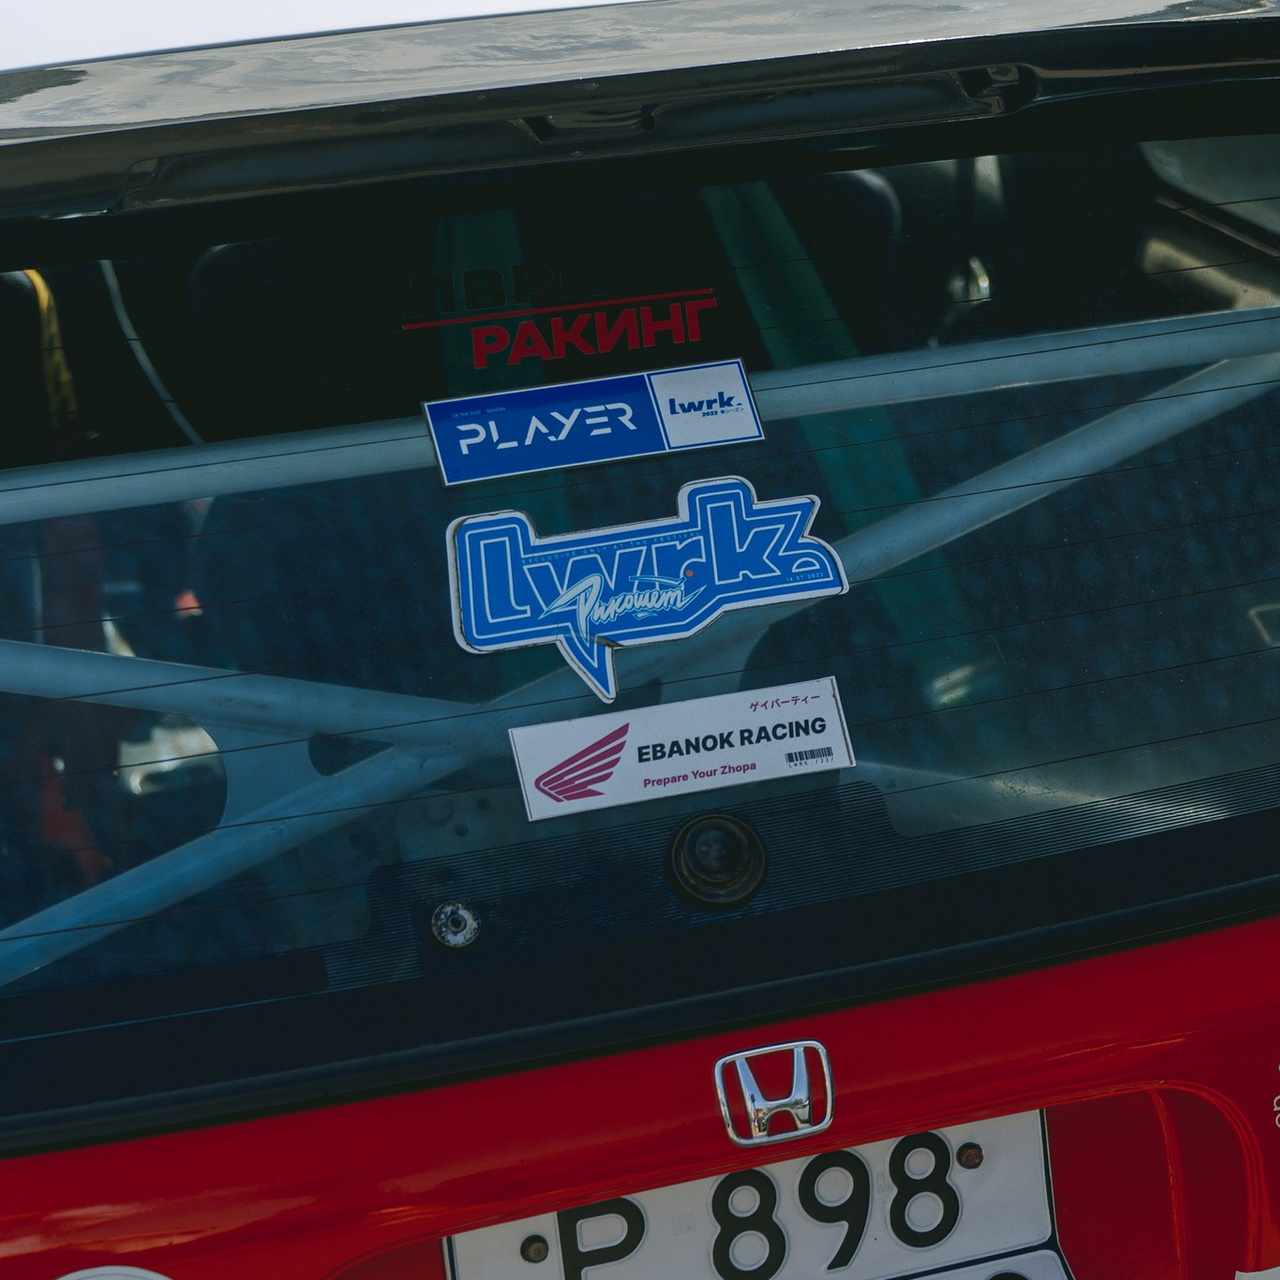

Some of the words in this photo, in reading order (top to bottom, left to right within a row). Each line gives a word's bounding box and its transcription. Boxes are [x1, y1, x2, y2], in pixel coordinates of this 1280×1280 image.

[471, 297, 717, 370] РАКИНГ
[456, 402, 638, 455] PLAYER
[522, 551, 576, 564] EXCLUSIVE
[583, 546, 608, 555] ONLY
[636, 730, 735, 763] EBANOK
[739, 717, 827, 746] RACING
[643, 773, 689, 788] Prepare
[691, 769, 718, 780] Your
[720, 762, 757, 775] Zhopa
